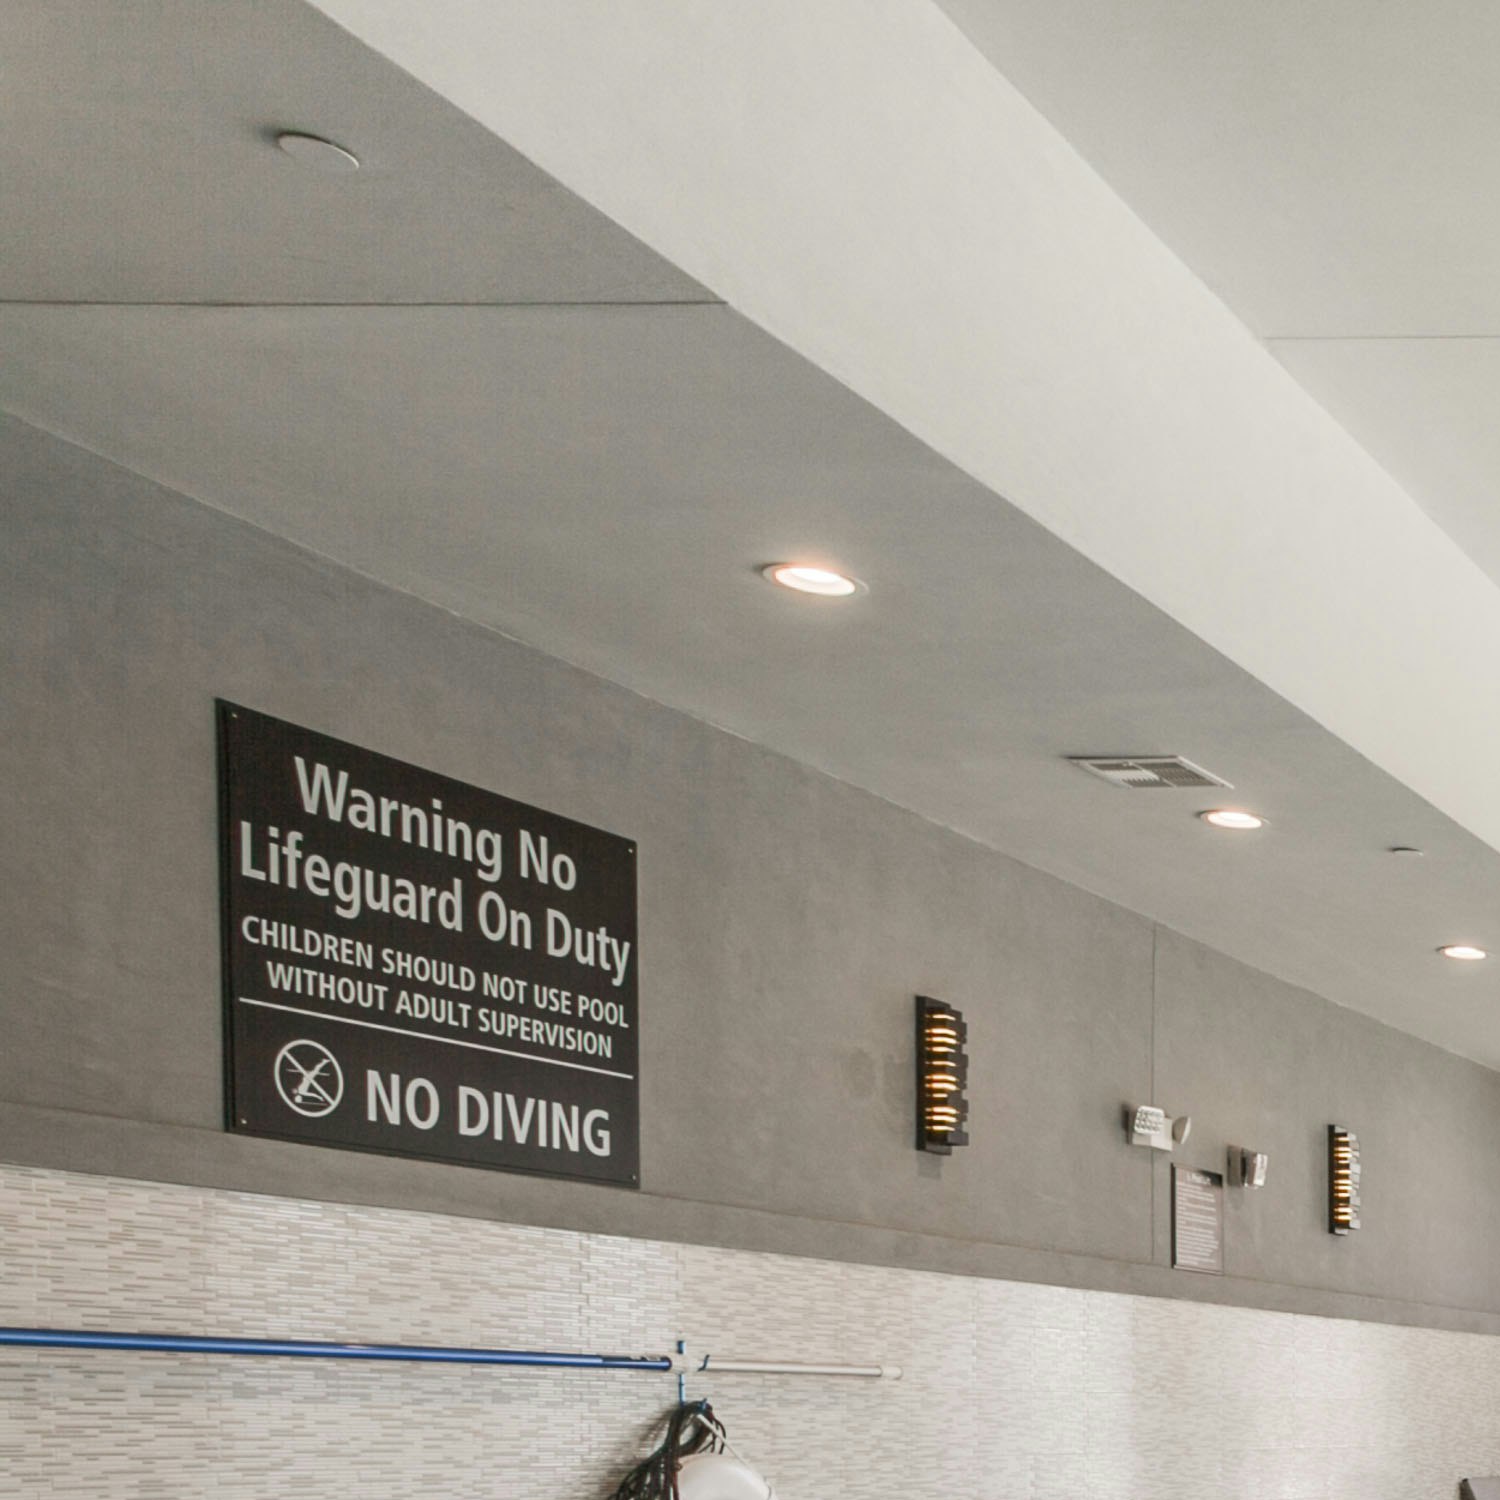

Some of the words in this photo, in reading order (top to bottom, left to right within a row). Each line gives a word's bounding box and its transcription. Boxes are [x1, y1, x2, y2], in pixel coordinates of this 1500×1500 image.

[295, 757, 502, 882] Warning
[520, 830, 577, 890] No
[241, 821, 463, 931] Lifeguard
[479, 891, 532, 949] On
[547, 908, 631, 986] Duty
[241, 915, 373, 970] CHILDREN
[381, 948, 476, 992] SHOULD
[483, 972, 528, 1005] NOT
[534, 984, 572, 1016] USE
[578, 995, 629, 1029] POOL
[266, 961, 389, 1011] WITHOUT
[395, 990, 472, 1029] ADULT
[478, 1008, 612, 1059] SUPERVISION
[366, 1070, 440, 1130] NO
[458, 1086, 611, 1157] DIVING
